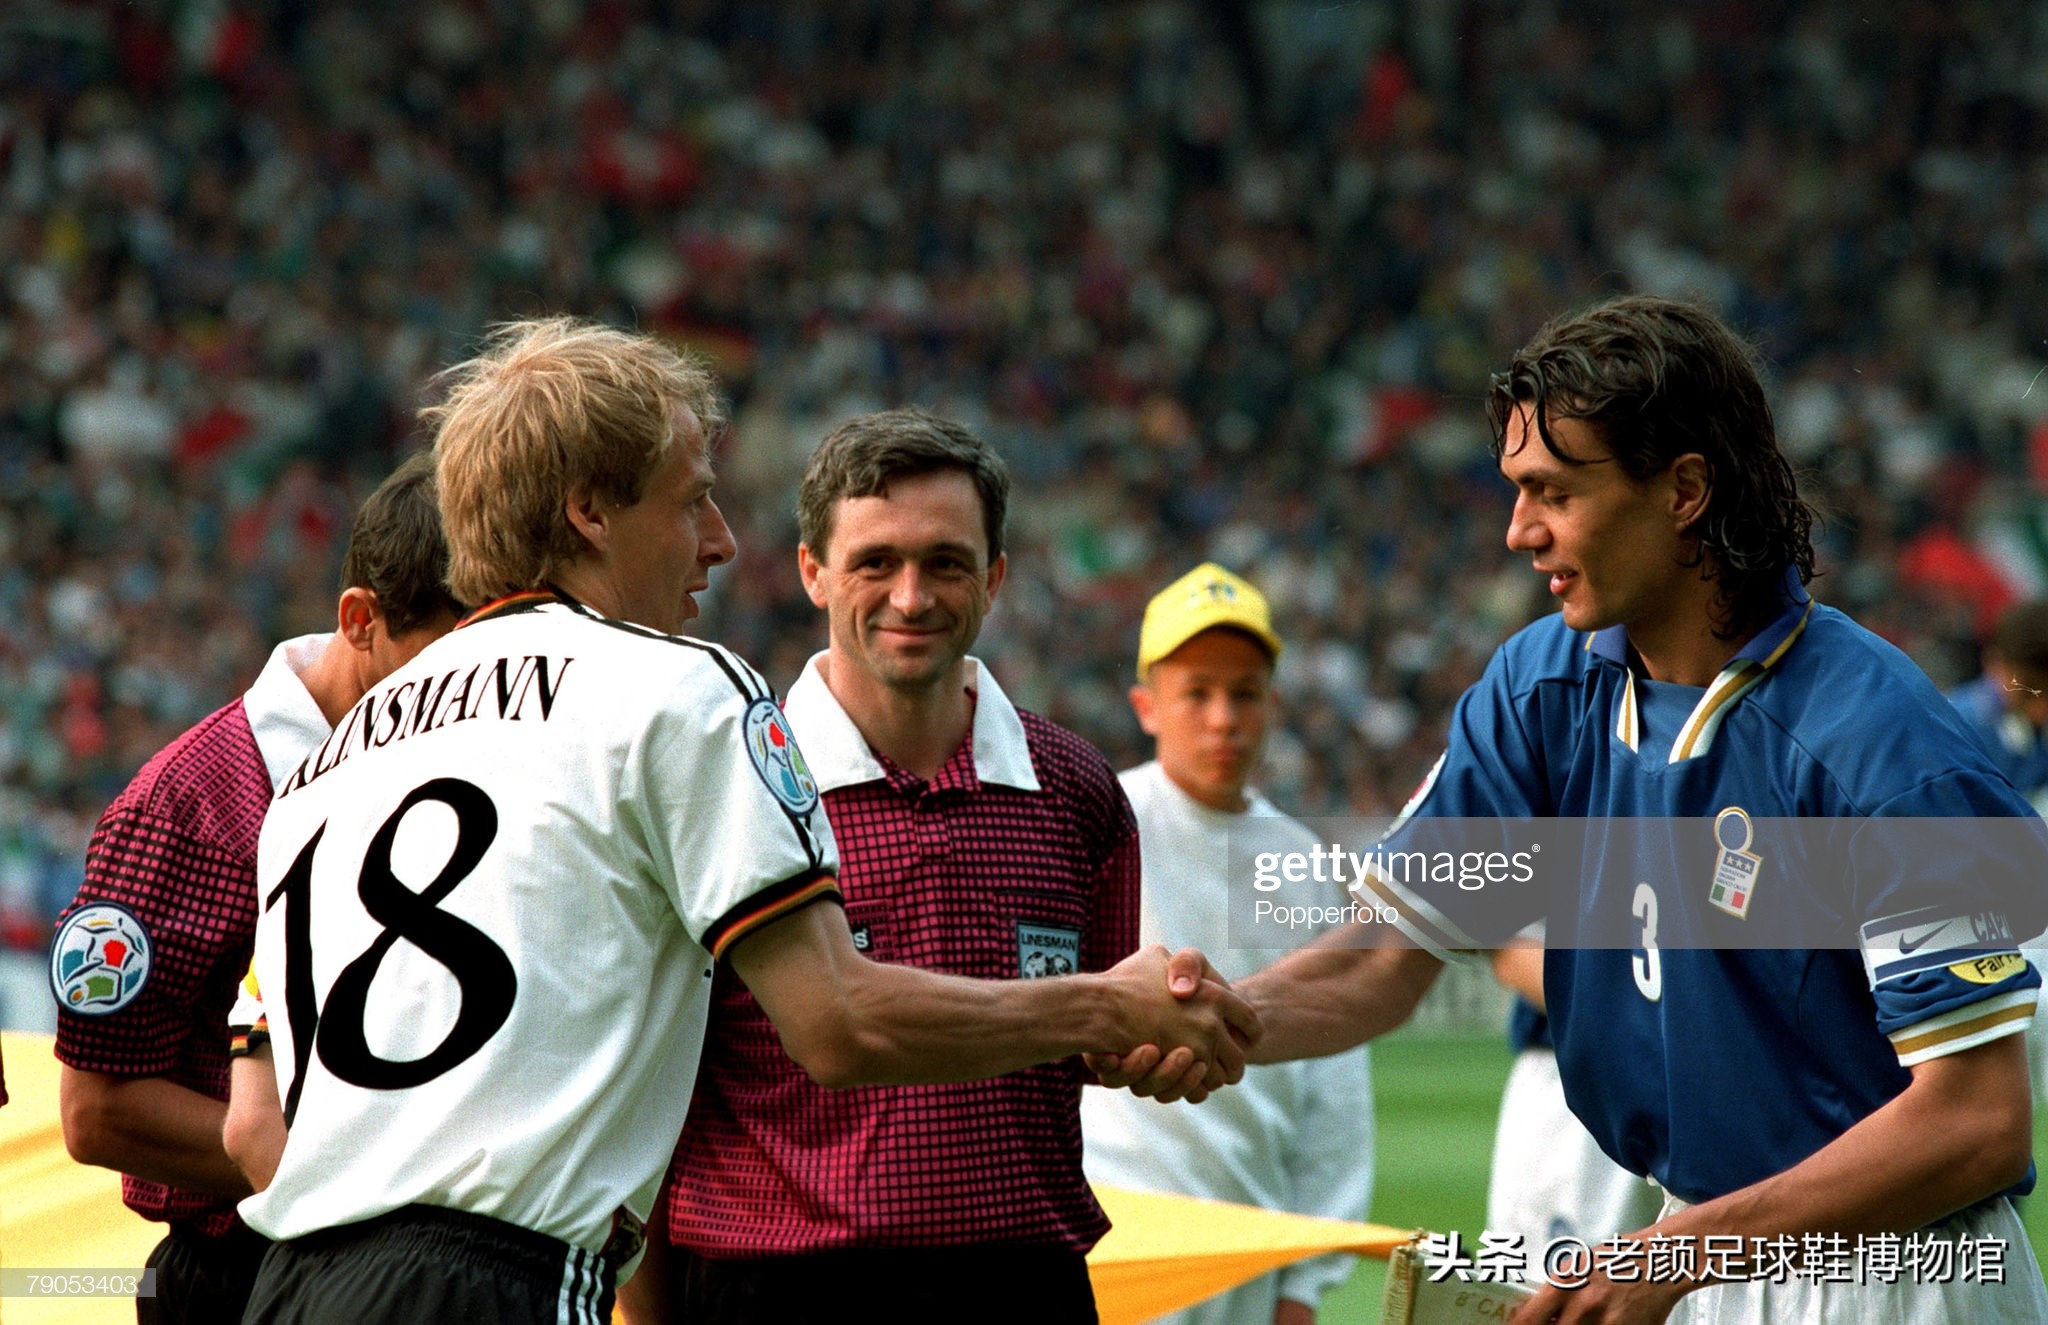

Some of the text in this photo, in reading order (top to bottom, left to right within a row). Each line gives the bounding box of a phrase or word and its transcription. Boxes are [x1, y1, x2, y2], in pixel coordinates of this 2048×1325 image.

[265, 777, 518, 1132] 18
[1021, 932, 1076, 952] LINESMAN
[1632, 881, 1662, 1002] 3
